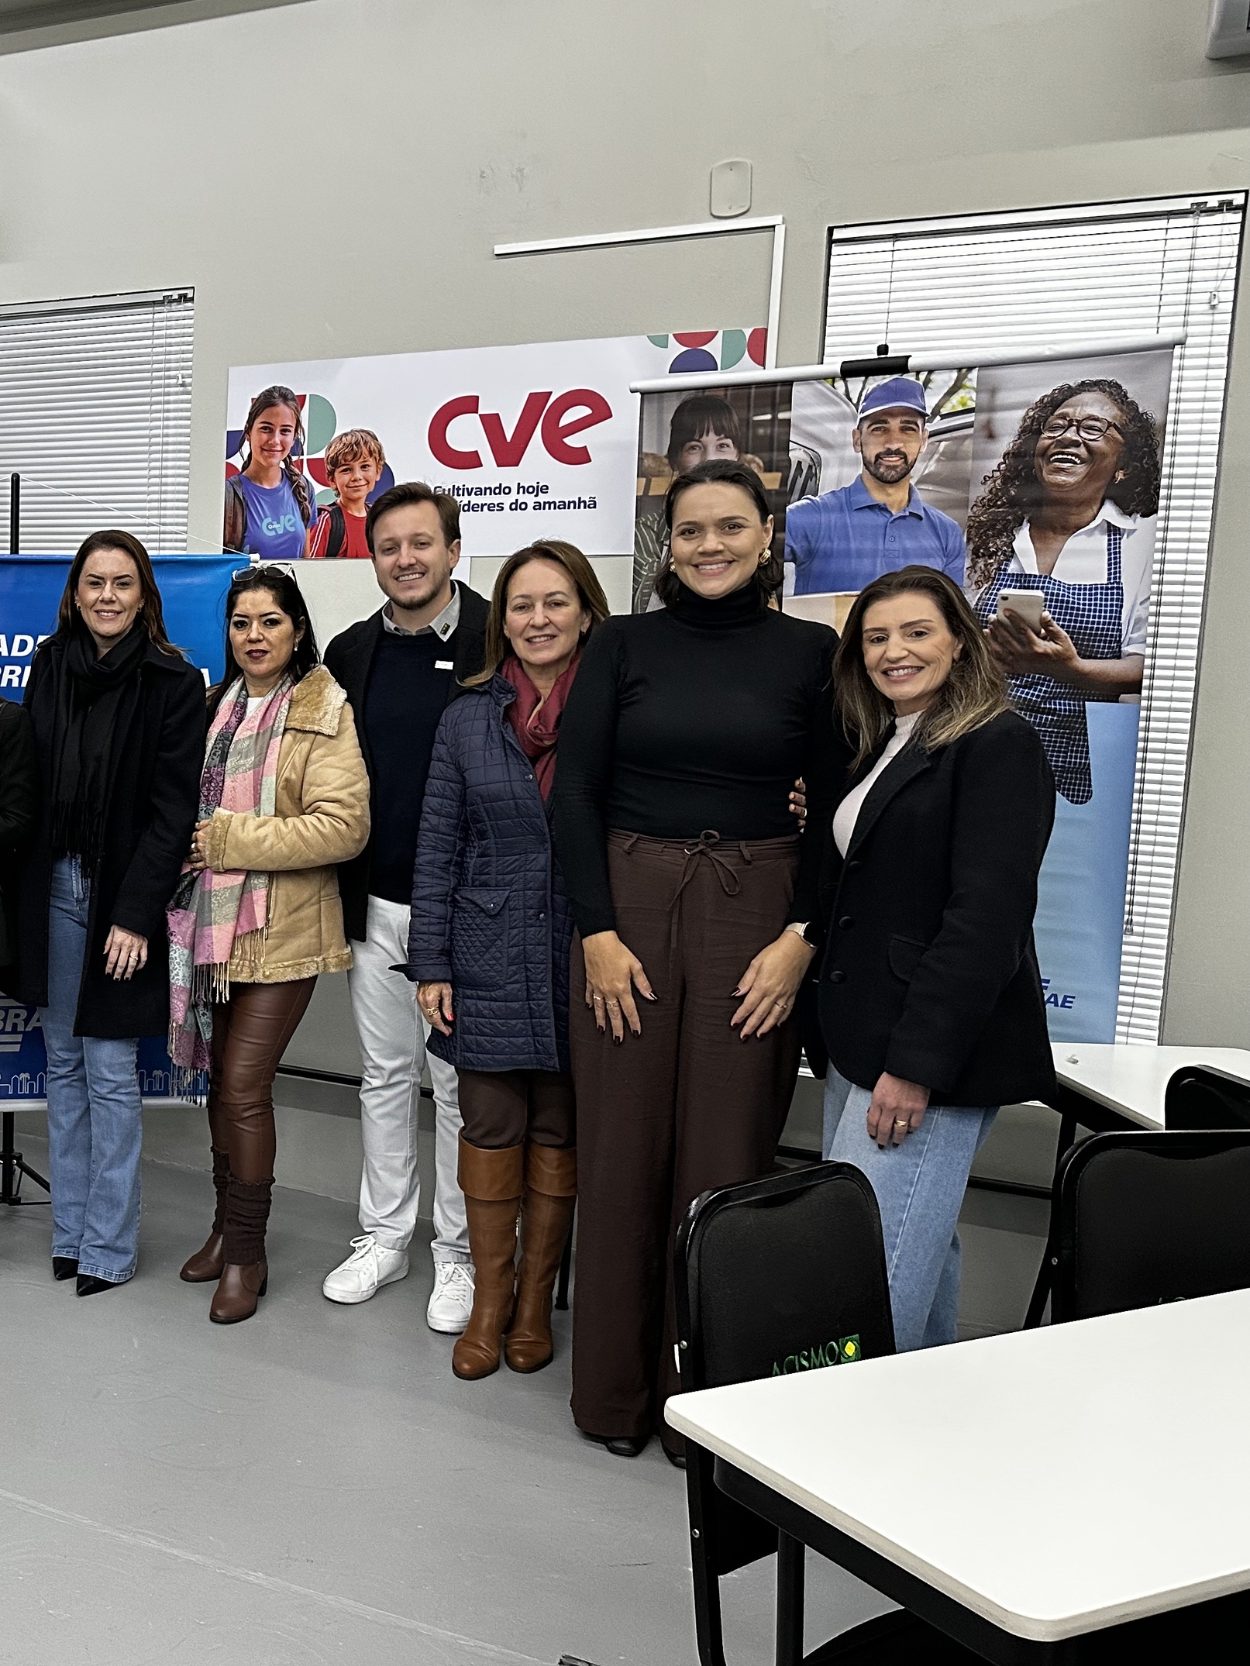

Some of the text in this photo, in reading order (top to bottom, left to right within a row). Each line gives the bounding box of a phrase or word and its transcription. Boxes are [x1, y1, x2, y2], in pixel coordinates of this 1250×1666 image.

[516, 482, 550, 498] hoje
[456, 496, 597, 513] íderes do amanhã
